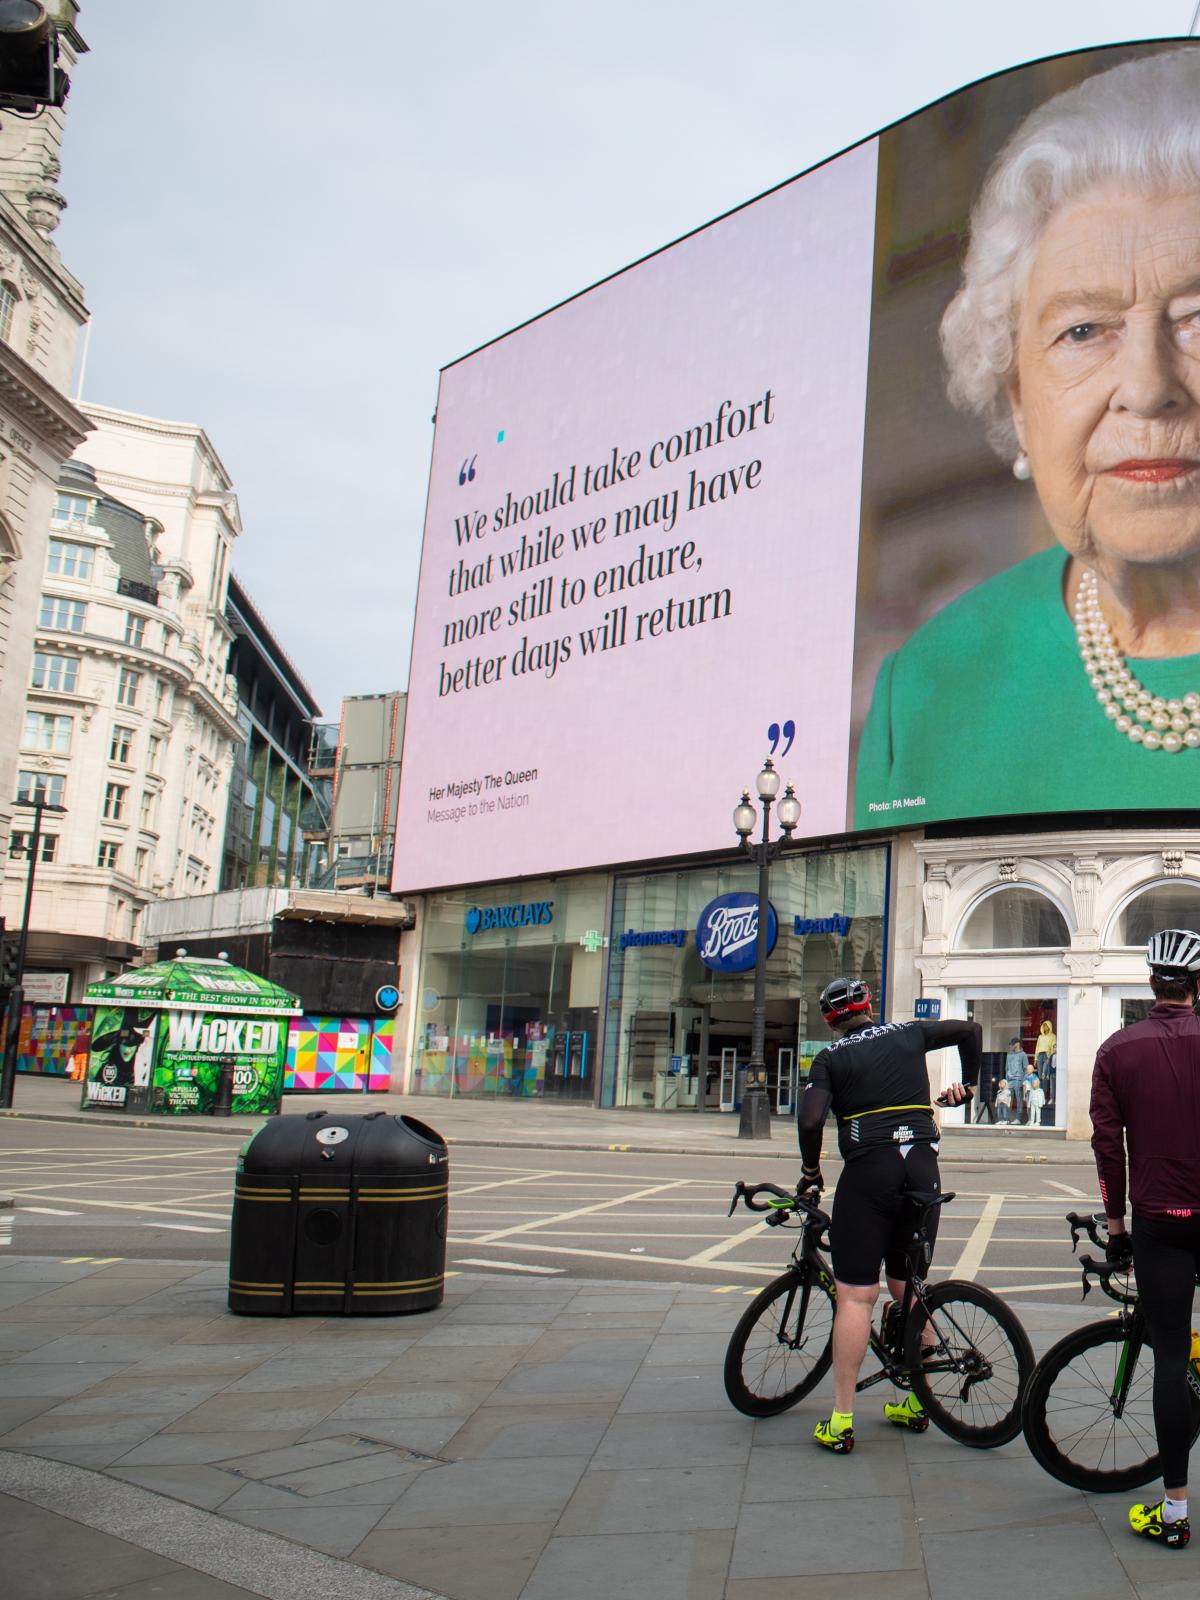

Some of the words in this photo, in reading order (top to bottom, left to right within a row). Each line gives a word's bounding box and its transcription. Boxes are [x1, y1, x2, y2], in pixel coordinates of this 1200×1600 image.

[453, 511, 487, 548] We
[493, 465, 577, 534] should
[583, 446, 641, 497] take
[649, 389, 776, 470] comfort
[448, 552, 495, 598] that
[500, 525, 565, 578] while
[571, 517, 606, 552] we
[613, 489, 680, 538] may
[686, 458, 763, 512] have
[442, 604, 502, 648] more
[508, 575, 554, 627] still
[561, 577, 586, 610] to
[594, 540, 703, 598] endure,
[438, 653, 507, 698] better
[511, 635, 572, 679] days
[578, 605, 628, 657] will
[634, 586, 733, 642] return
[429, 787, 446, 802] Her
[446, 778, 483, 799] Majesty
[484, 774, 503, 790] The
[504, 768, 539, 786] Queen
[427, 805, 467, 823] Message
[468, 801, 479, 817] to
[480, 799, 496, 814] the
[497, 793, 530, 811] Nation
[868, 801, 892, 812] Photo:
[892, 799, 903, 809] PA
[903, 796, 926, 807] Media
[481, 901, 554, 930] BARCLAYS
[794, 912, 850, 937] beauty
[617, 928, 688, 953] pharmacy
[200, 993, 221, 1003] BEST
[222, 995, 247, 1004] SHOW
[917, 1003, 928, 1014] GAP
[931, 1003, 940, 1014] GAP
[233, 1071, 253, 1085] 100
